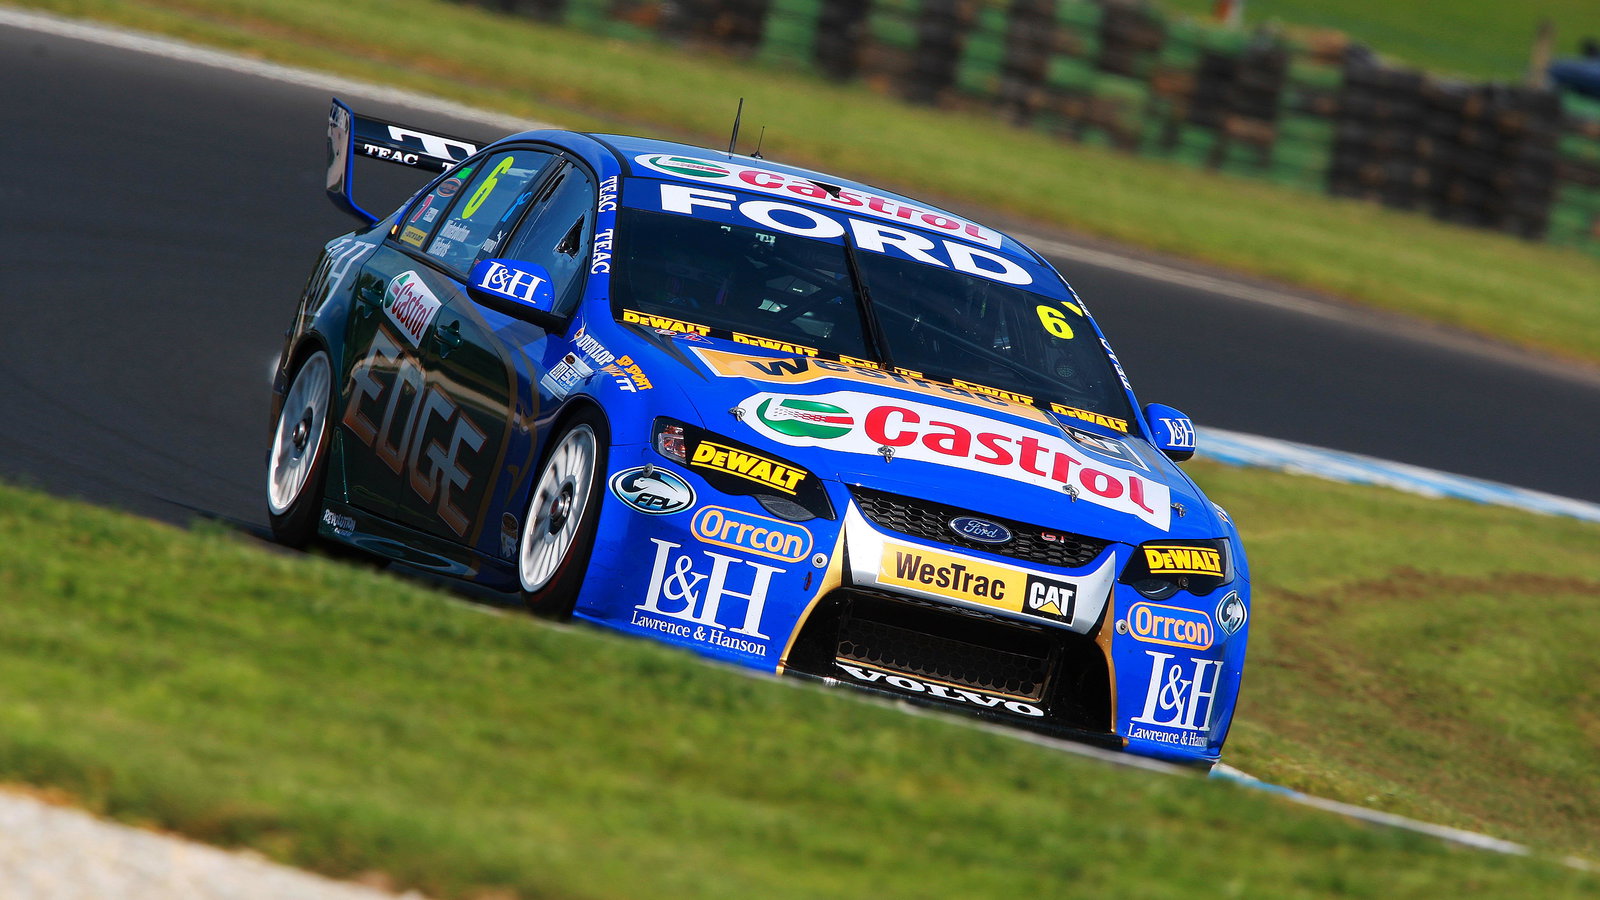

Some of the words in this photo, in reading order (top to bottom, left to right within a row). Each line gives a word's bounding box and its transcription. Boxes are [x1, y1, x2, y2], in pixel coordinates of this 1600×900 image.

[363, 143, 419, 165] TEAC
[461, 156, 514, 219] 6
[597, 175, 618, 213] TEAC
[738, 169, 988, 241] Castrol
[590, 228, 614, 275] TEAC
[660, 184, 1034, 286] FORD
[477, 261, 547, 304] L&H
[391, 282, 433, 340] Castrol
[1036, 304, 1075, 340] 6
[576, 333, 616, 366] DUNLOP
[615, 355, 634, 367] SP
[624, 364, 653, 391] SPORT
[342, 323, 488, 538] EDGE
[1159, 418, 1197, 448] L&H
[691, 443, 806, 492] DEWALT
[863, 405, 1155, 515] Castrol
[633, 491, 684, 511] FPV
[700, 509, 804, 558] Orrcon
[964, 520, 999, 538] Ford
[895, 551, 1006, 601] WesTrac
[1144, 549, 1222, 573] DEWALT
[634, 537, 787, 641] L&H
[1028, 581, 1075, 616] CAT
[630, 610, 691, 642] Lawrence
[693, 625, 707, 643] &
[708, 629, 767, 656] Hanson
[1135, 606, 1209, 646] Orrcon
[835, 662, 1045, 717] VOLVO
[1130, 650, 1225, 732] L&H
[1127, 722, 1180, 744] Lawrence
[1180, 730, 1189, 746] &
